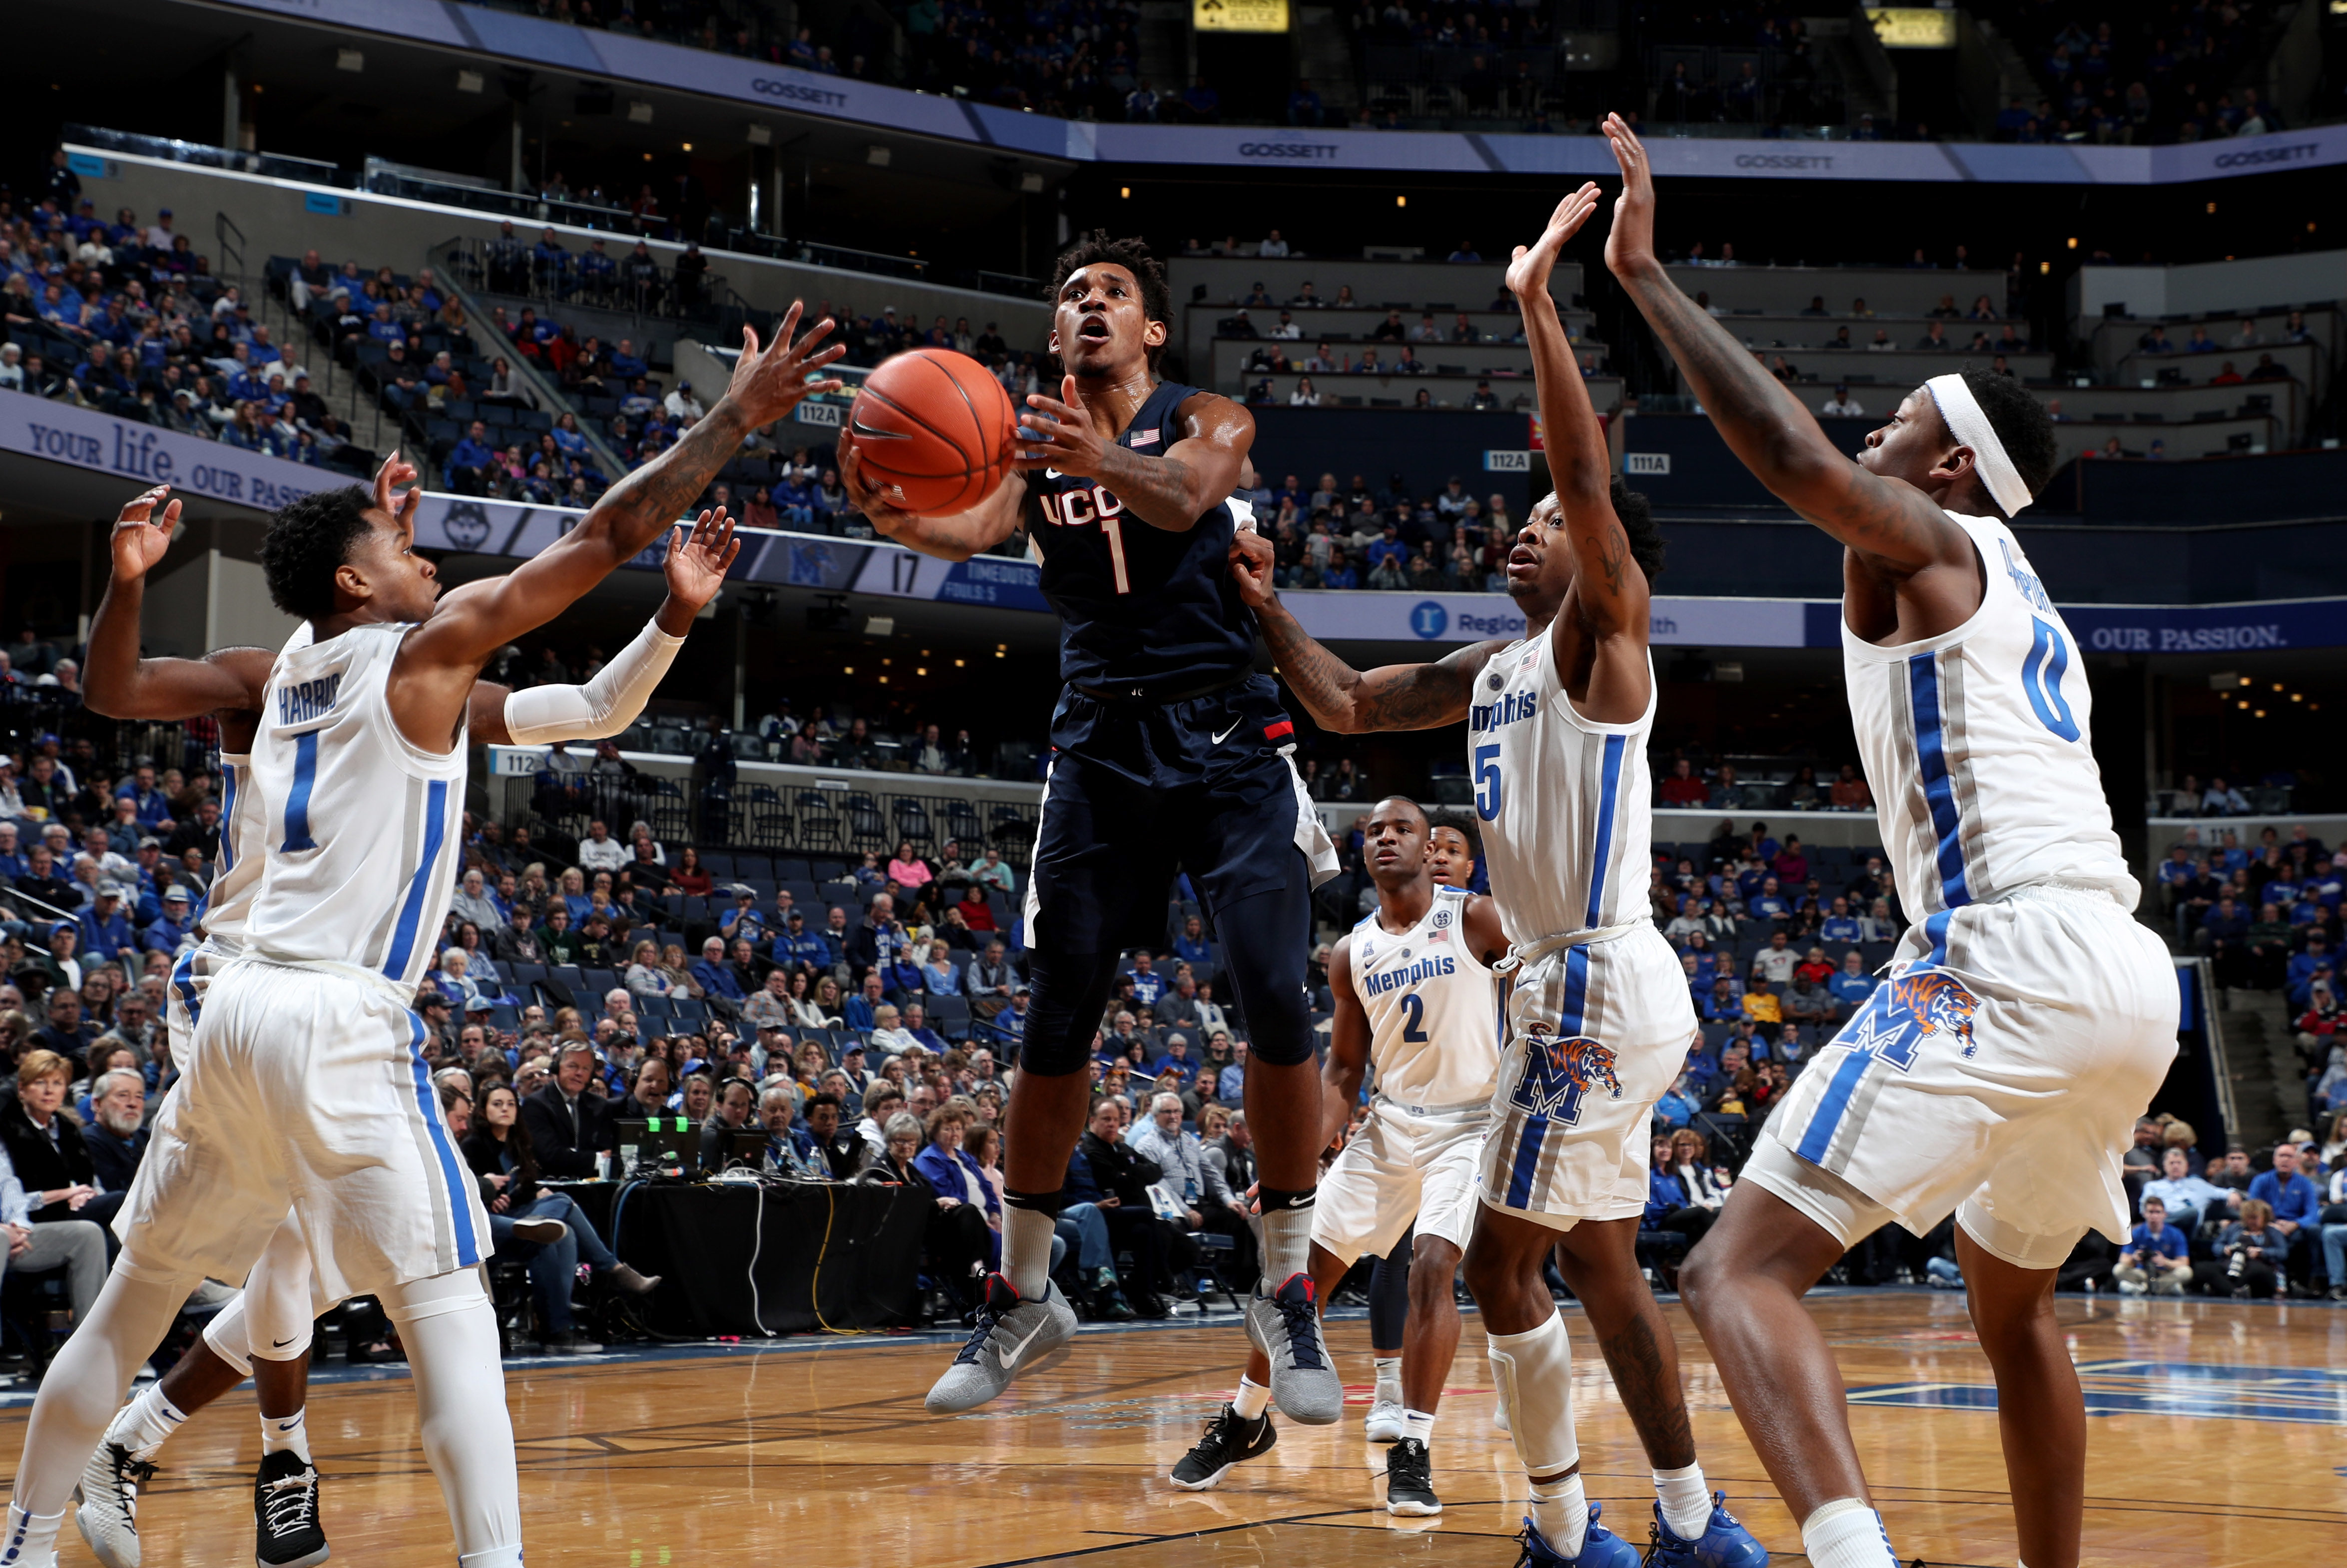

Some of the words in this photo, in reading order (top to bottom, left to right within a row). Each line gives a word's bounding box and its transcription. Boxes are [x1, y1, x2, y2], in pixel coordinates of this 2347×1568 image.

[752, 78, 848, 107] GOSSETT
[1239, 143, 1339, 158] GOSSETT
[1735, 154, 1833, 169] GOSSETT
[2215, 143, 2320, 168] GOSSETT
[802, 405, 837, 423] 112A
[27, 423, 103, 465] YOUR
[111, 423, 181, 484] life.
[192, 464, 243, 498] OUR
[250, 477, 311, 508] PASS
[1492, 454, 1526, 468] 112A
[1632, 457, 1665, 470] 111A
[893, 553, 920, 593] 17
[1101, 517, 1131, 595] 1
[1650, 616, 1677, 634] lth
[2091, 628, 2151, 650] OUR
[2160, 625, 2288, 650] PASSION.
[2021, 613, 2081, 743] 0
[279, 673, 341, 726] HARRIS
[1471, 690, 1536, 733] mphis
[507, 755, 534, 773] 112
[279, 728, 320, 853] 1
[1475, 744, 1501, 821] 5
[1364, 955, 1455, 997] Memphis
[1401, 993, 1428, 1043] 2
